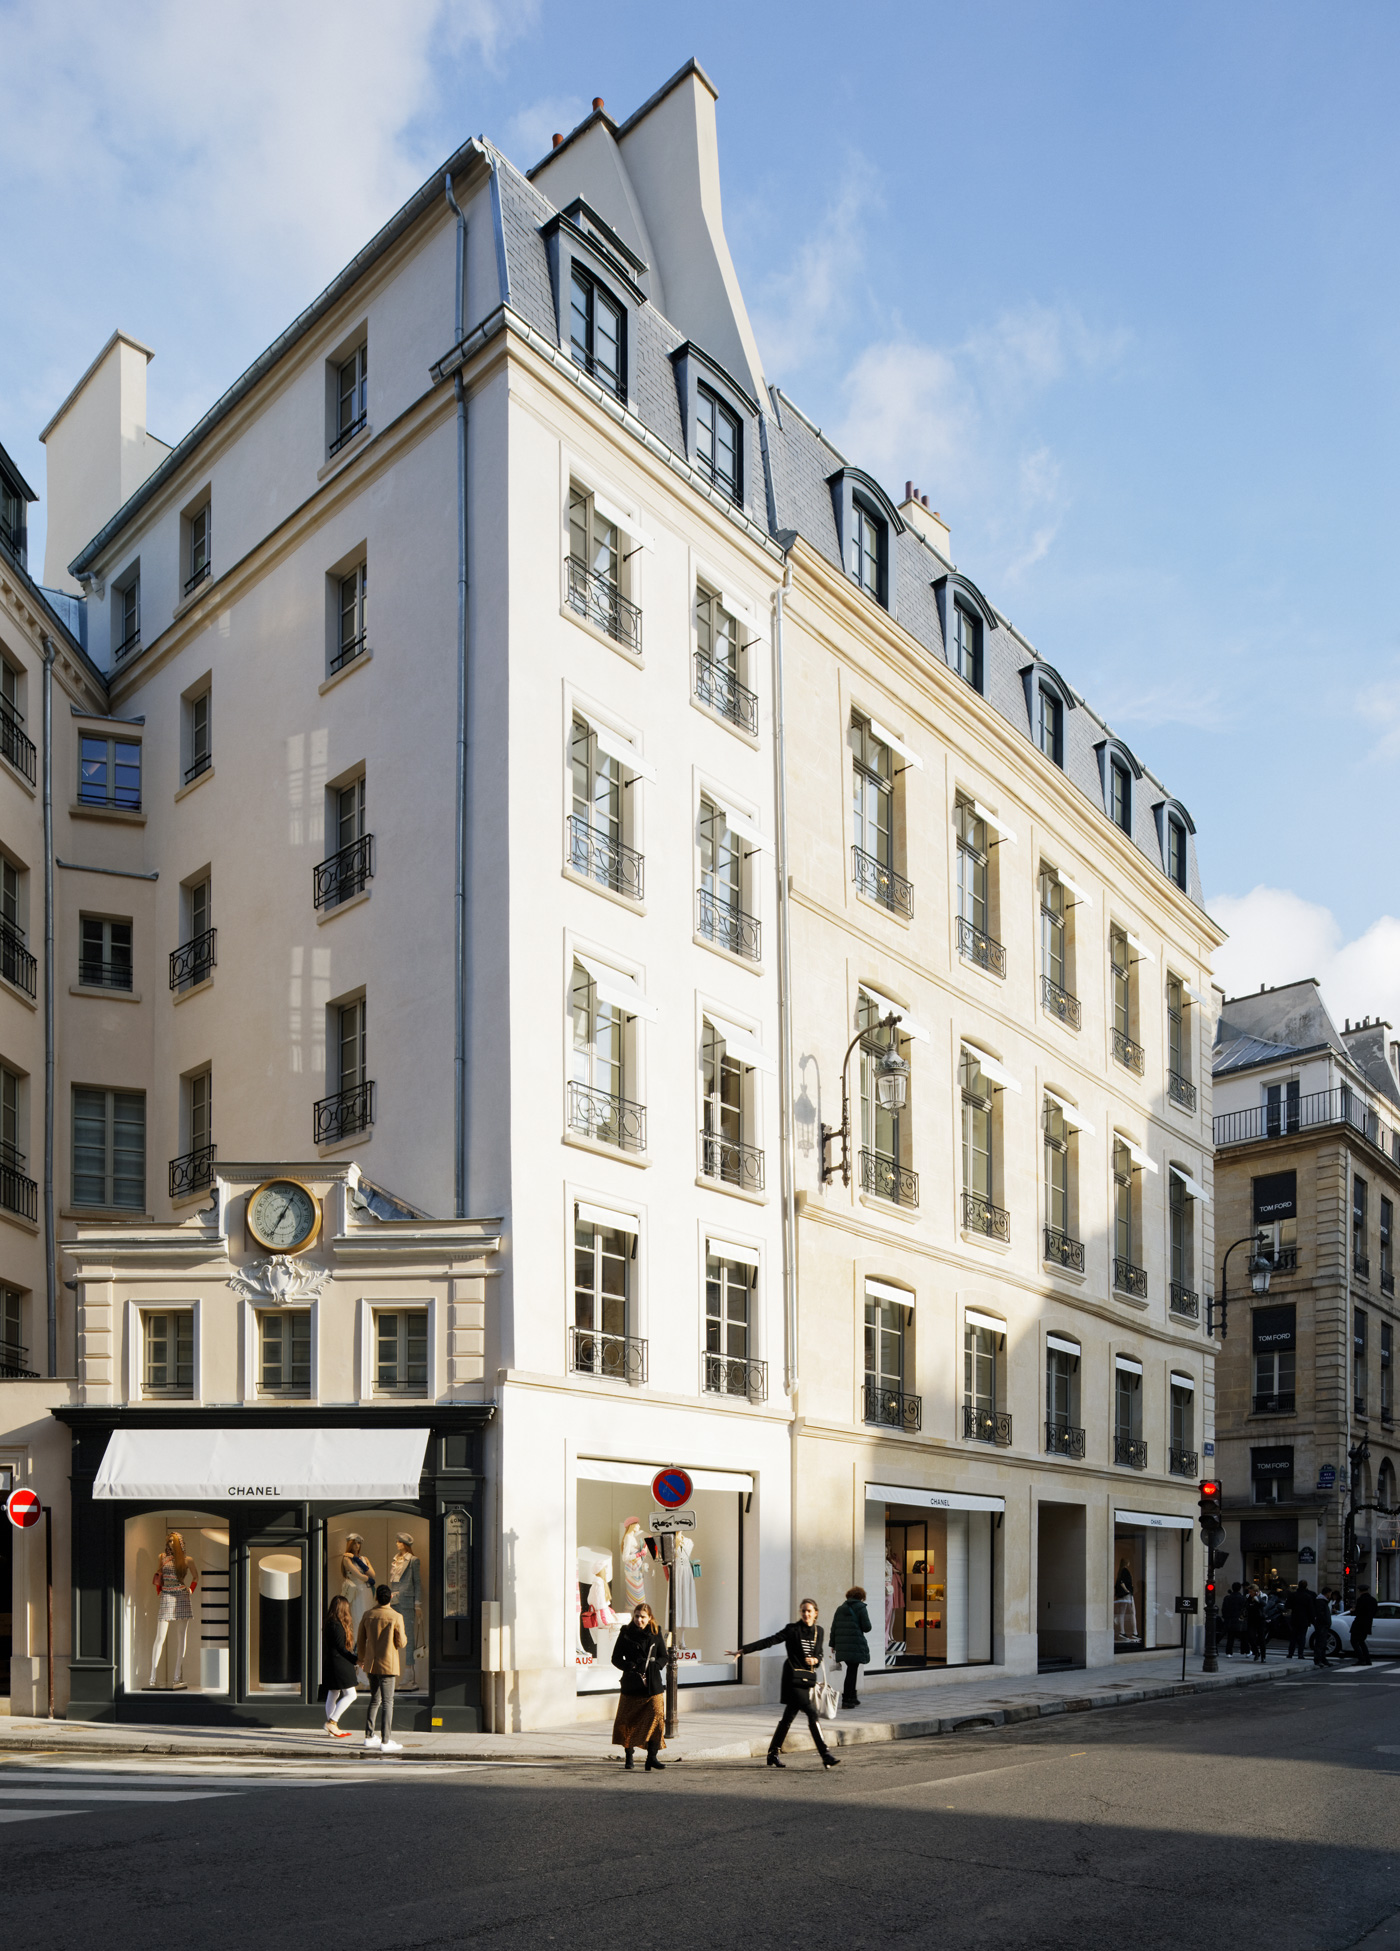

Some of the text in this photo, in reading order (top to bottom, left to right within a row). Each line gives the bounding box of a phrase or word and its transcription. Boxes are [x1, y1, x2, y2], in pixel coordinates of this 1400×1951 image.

[1274, 1201, 1292, 1210] FORD
[228, 1486, 281, 1496] CHANEL
[930, 1498, 950, 1506] CHANEL
